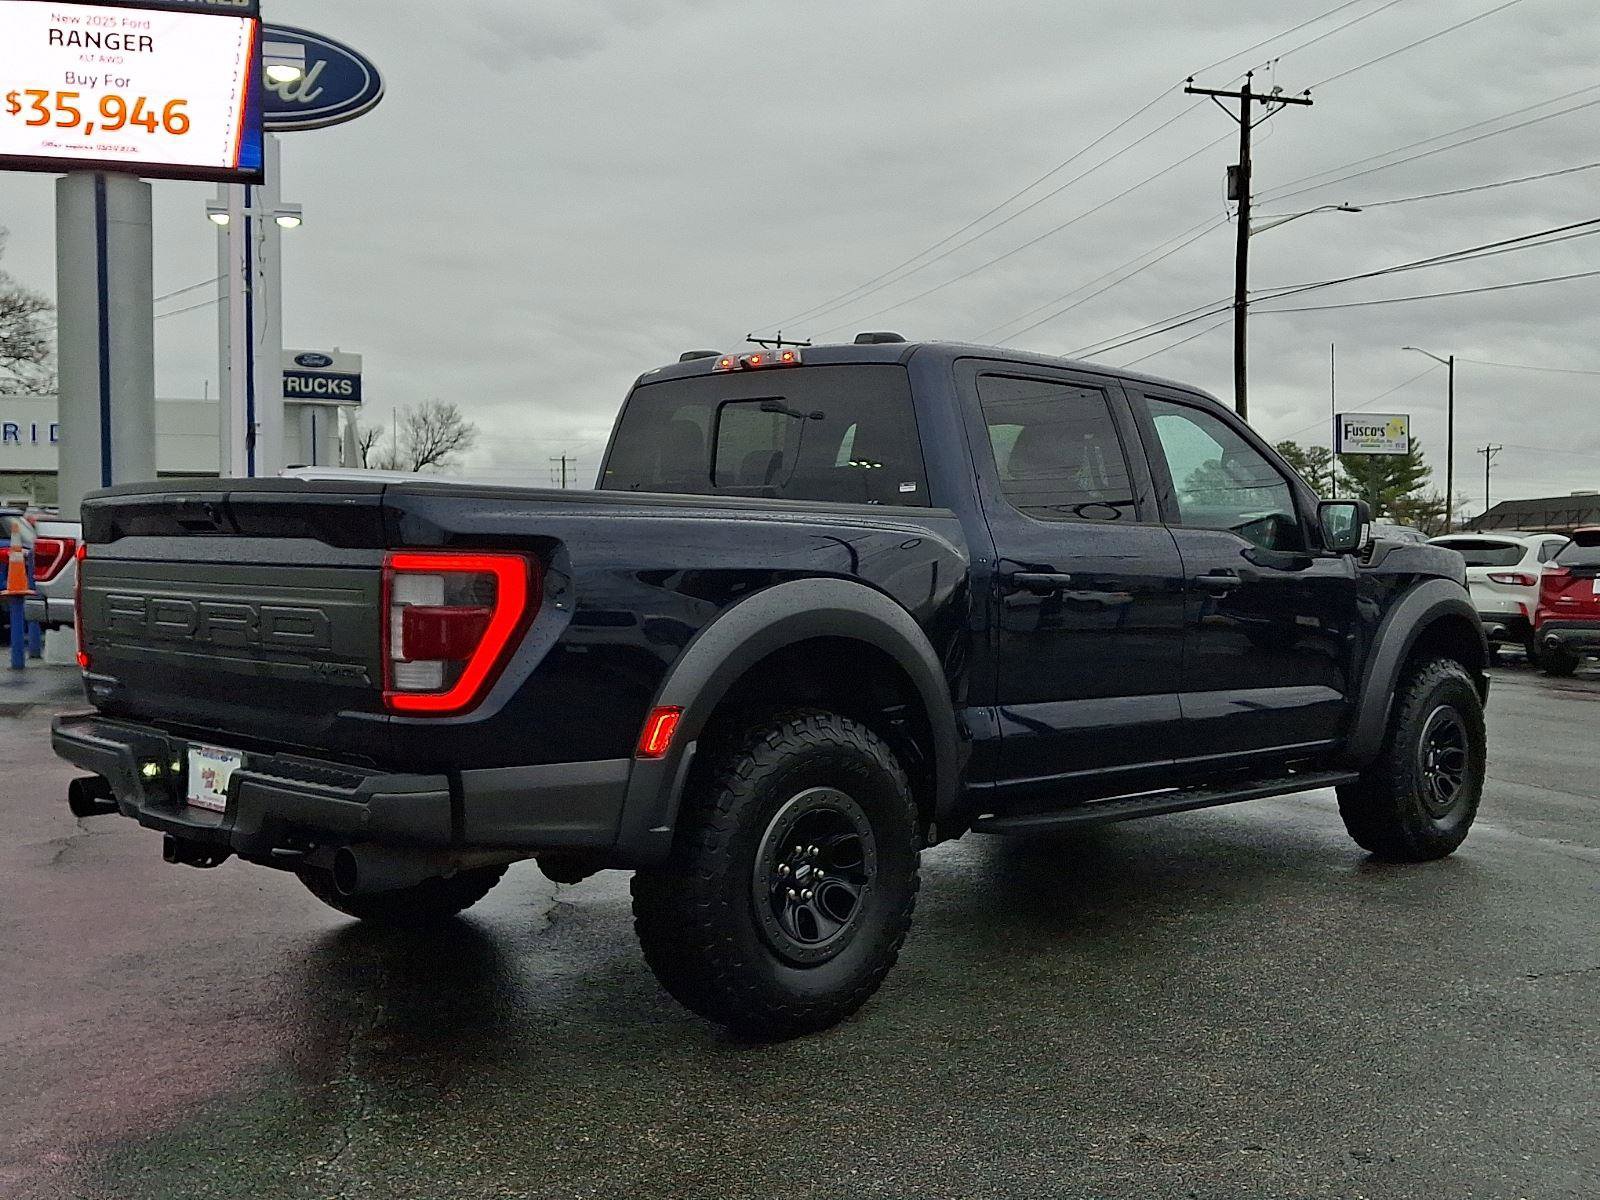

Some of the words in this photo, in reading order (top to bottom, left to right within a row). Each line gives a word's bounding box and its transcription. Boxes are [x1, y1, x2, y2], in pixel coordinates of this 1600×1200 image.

[48, 28, 154, 53] RANGER
[65, 71, 98, 89] Buy
[104, 74, 131, 88] For
[5, 89, 190, 136] $35,946
[104, 593, 332, 652] FORD
